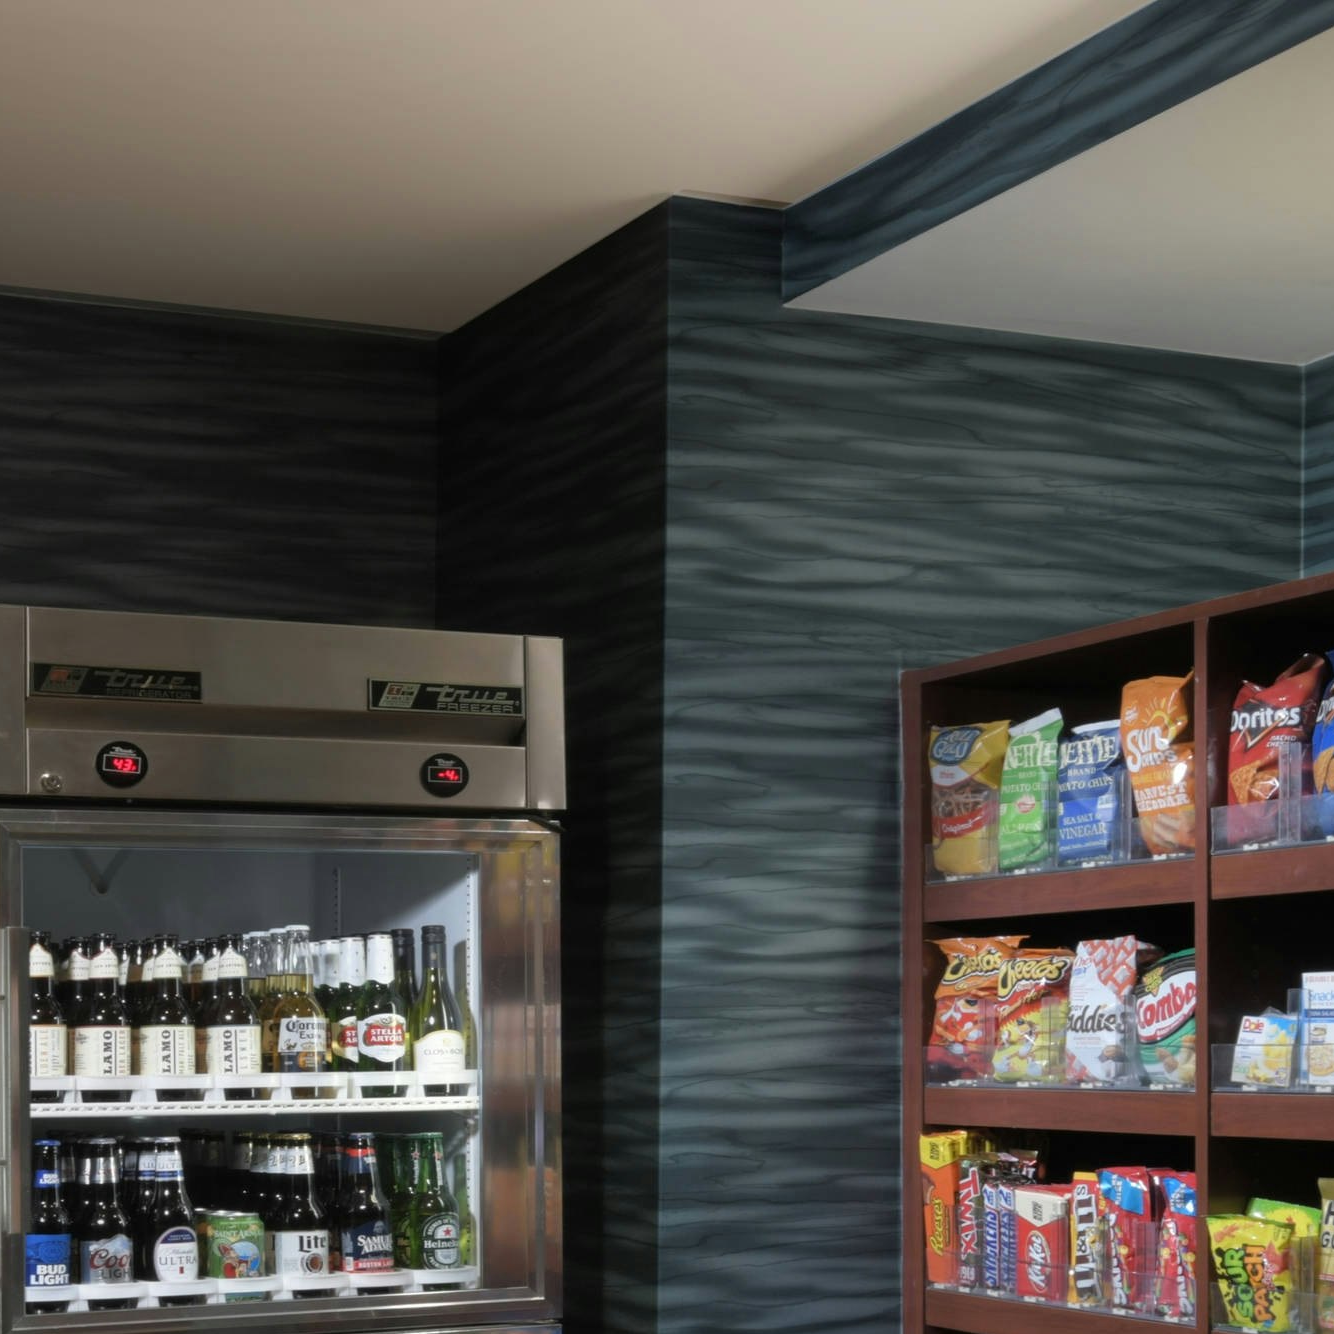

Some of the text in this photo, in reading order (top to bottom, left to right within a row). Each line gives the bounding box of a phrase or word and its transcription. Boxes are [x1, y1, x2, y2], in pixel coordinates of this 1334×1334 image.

[437, 702, 513, 713] FREEZER
[1230, 707, 1301, 732] Doritos
[1059, 822, 1107, 841] VINEGAR
[998, 955, 1064, 999] Cheetos
[1136, 981, 1196, 1030] Combo
[1067, 1004, 1127, 1034] uddies
[370, 1028, 402, 1036] STELLA
[370, 1035, 403, 1043] ARTOIS
[103, 1030, 113, 1075] LAMO
[161, 1029, 171, 1073] LAMO
[224, 1029, 233, 1073] LAMO
[299, 1235, 327, 1252] Lite
[423, 1239, 459, 1249] Heinek
[36, 1264, 67, 1275] BUD
[90, 1249, 131, 1270] Coo
[30, 1274, 69, 1286] LIGHT
[1225, 1246, 1255, 1318] SOUR
[1242, 1243, 1276, 1322] PATCH
